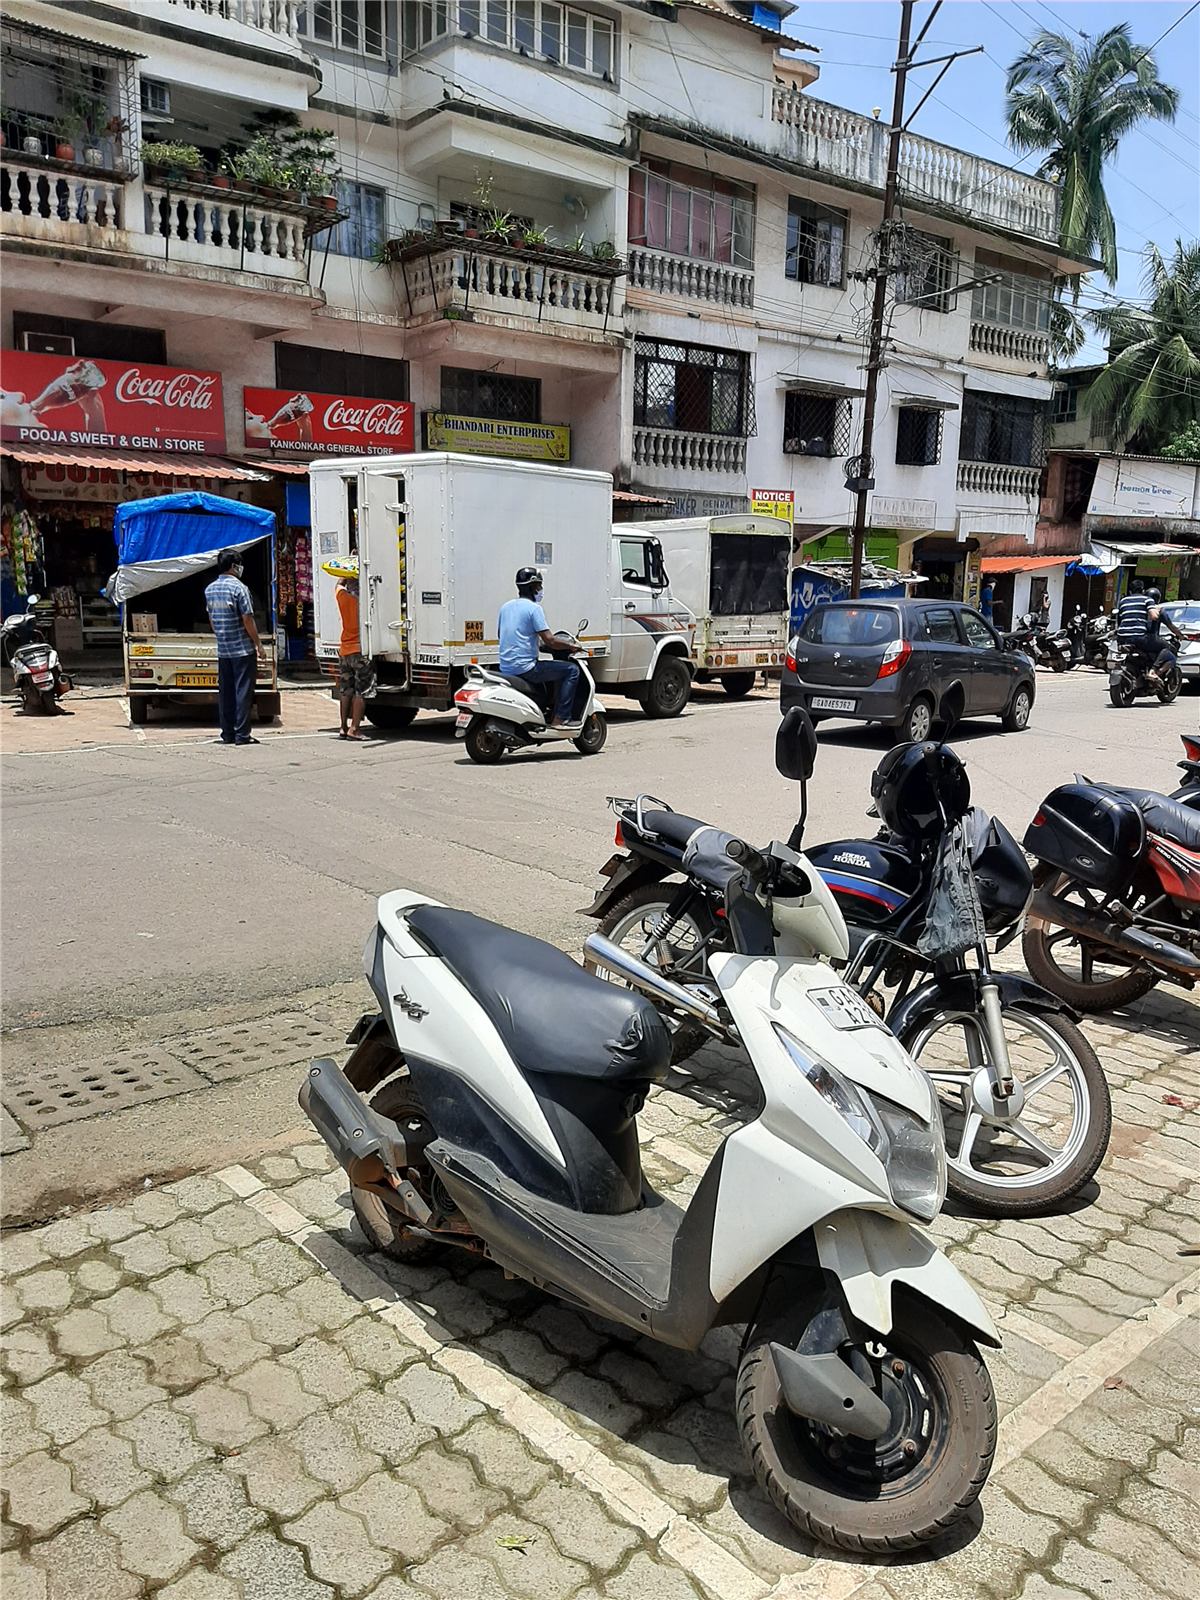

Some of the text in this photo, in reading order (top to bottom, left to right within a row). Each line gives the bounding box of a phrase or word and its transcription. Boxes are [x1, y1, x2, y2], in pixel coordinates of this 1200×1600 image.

[115, 368, 217, 411] Coca-Cola
[323, 399, 409, 437] Coca-Cola
[444, 418, 555, 440] BHANDARI ENTERPRISES
[20, 428, 205, 452] POOJA SWEET & GEN. STORE
[270, 439, 325, 452] KANKONKAR
[327, 444, 366, 455] GENERAL
[367, 446, 394, 456] STORE
[755, 491, 791, 501] NOTICE
[418, 653, 441, 665] PLEASE
[832, 854, 871, 869] HONDA
